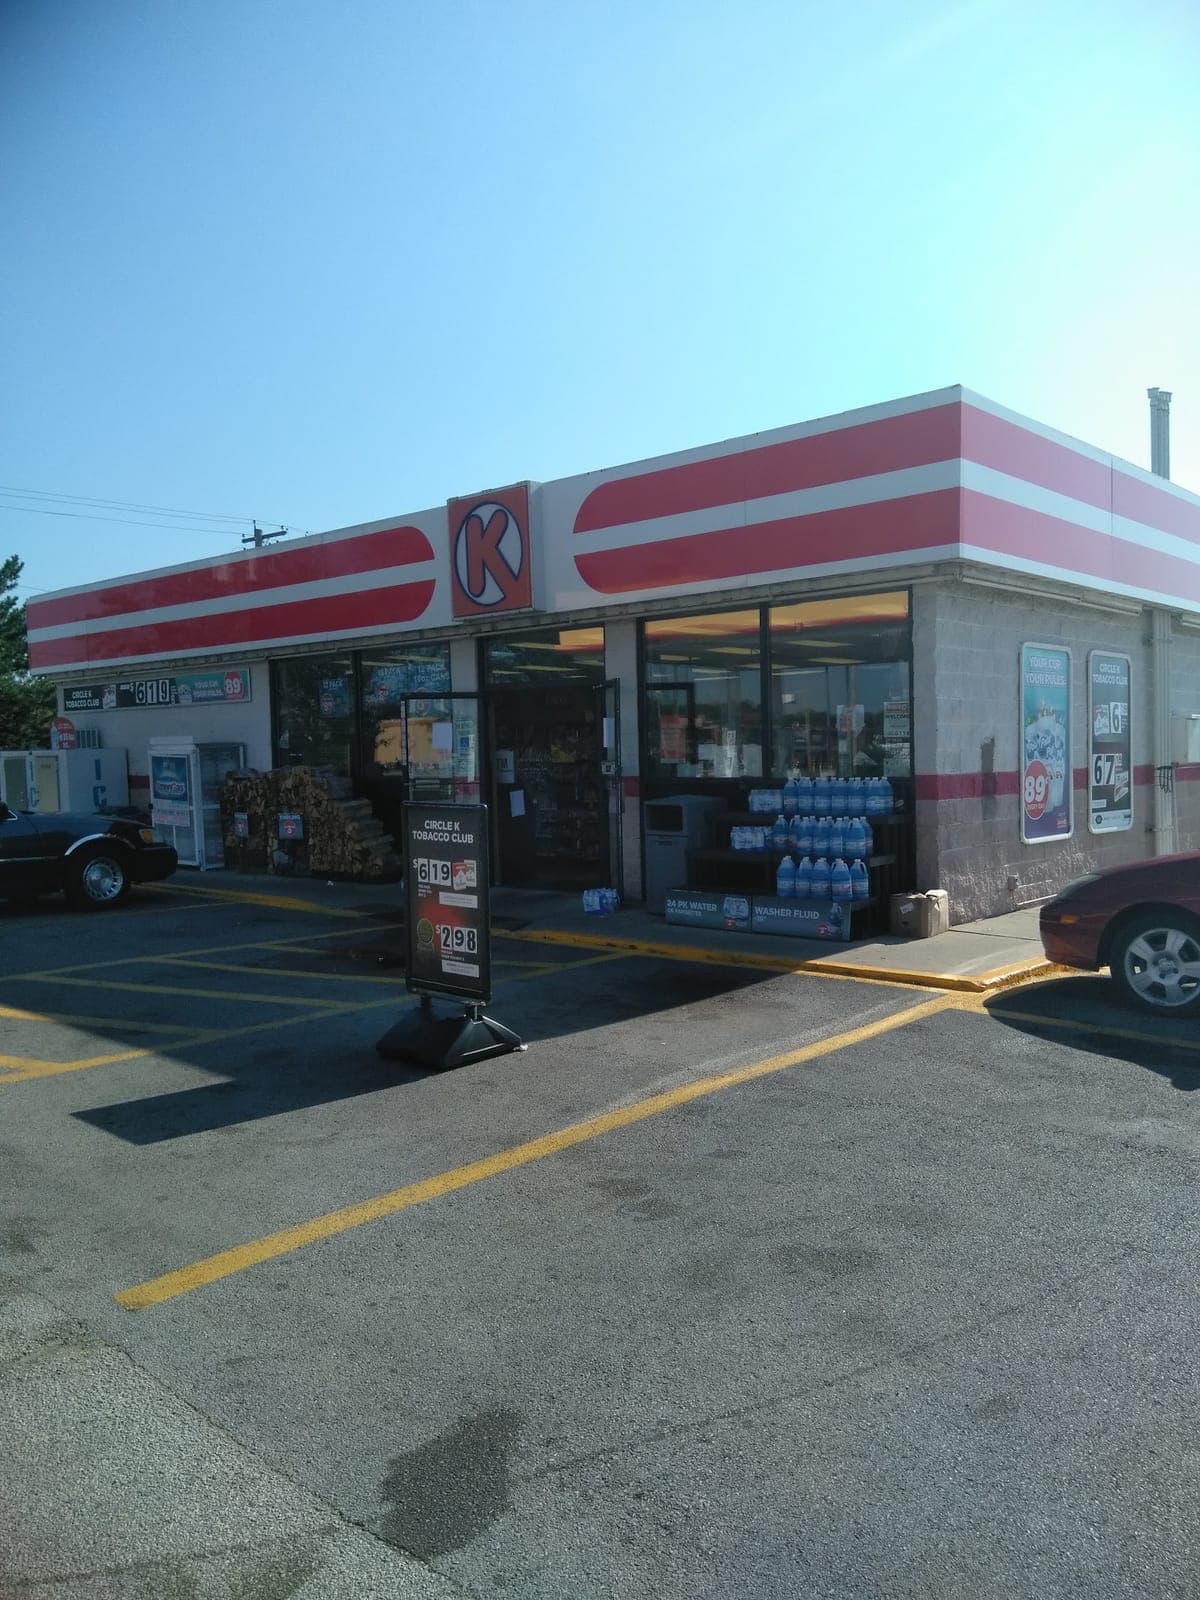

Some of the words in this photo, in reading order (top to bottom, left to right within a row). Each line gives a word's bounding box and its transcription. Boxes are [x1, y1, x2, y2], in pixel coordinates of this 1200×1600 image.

[465, 508, 521, 599] K
[65, 699, 87, 709] TOBACCO
[87, 698, 100, 707] CLUB
[424, 819, 454, 832] CIRCLE
[454, 822, 461, 832] K
[411, 830, 450, 843] TOBACCO
[451, 833, 474, 844] CLUB
[666, 899, 677, 908] 24
[677, 900, 689, 909] PK
[689, 901, 718, 912] WATER
[754, 906, 793, 918] WASHER
[793, 910, 820, 921] FLUID
